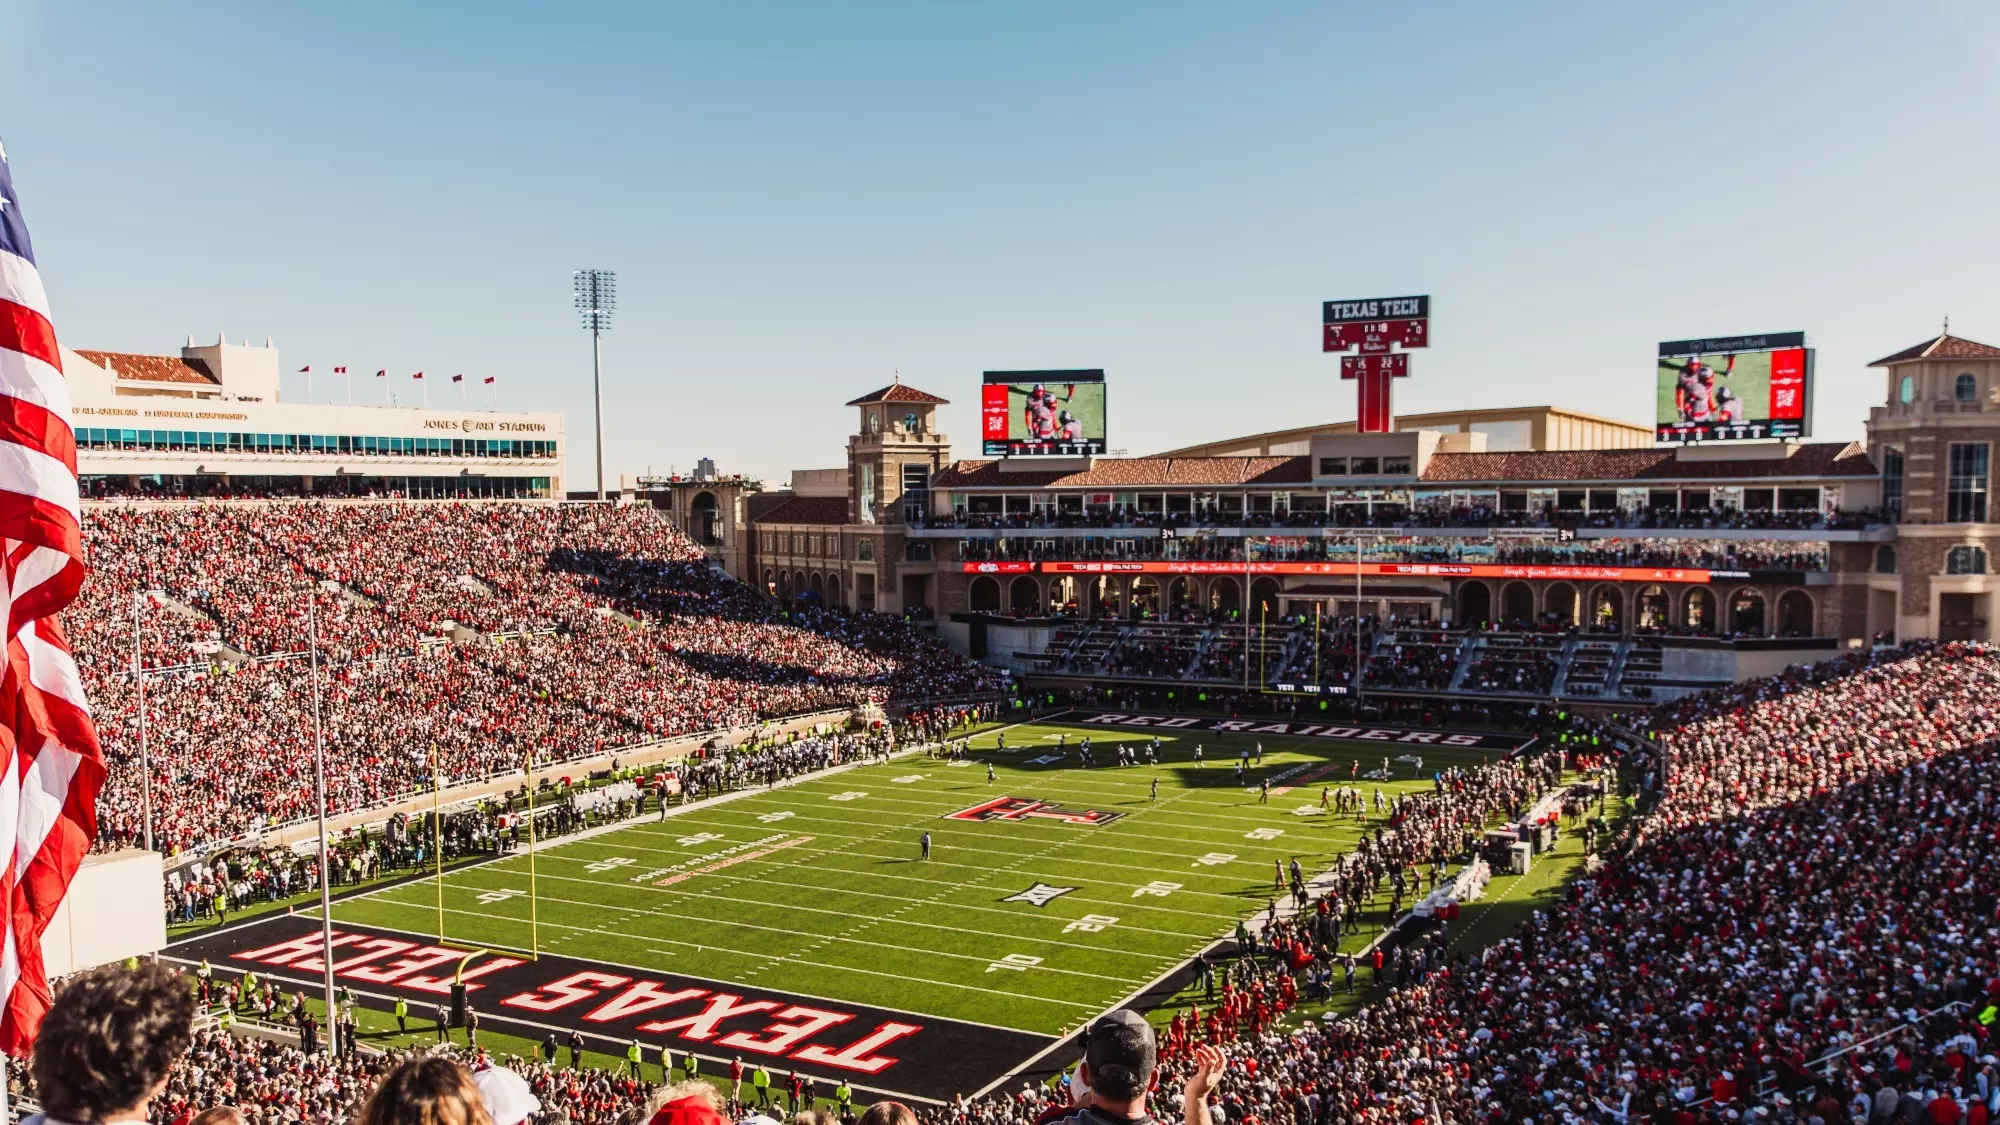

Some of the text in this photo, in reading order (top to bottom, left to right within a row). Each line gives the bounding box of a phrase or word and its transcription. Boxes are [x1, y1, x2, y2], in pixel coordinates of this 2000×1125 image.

[1332, 299, 1419, 318] TEXAS TECH
[424, 420, 458, 429] JONES
[499, 422, 546, 432] STADIUM
[1162, 528, 1174, 539] 34
[1560, 530, 1574, 540] 34
[1277, 684, 1294, 692] YETI
[1083, 714, 1485, 746] RED RAIDERS
[630, 863, 686, 882] JONES
[722, 833, 790, 854] STADIUM
[1141, 880, 1184, 897] 30
[1071, 913, 1120, 932] 20
[991, 953, 1044, 972] 10
[229, 930, 924, 1074] TEXAS TECH
